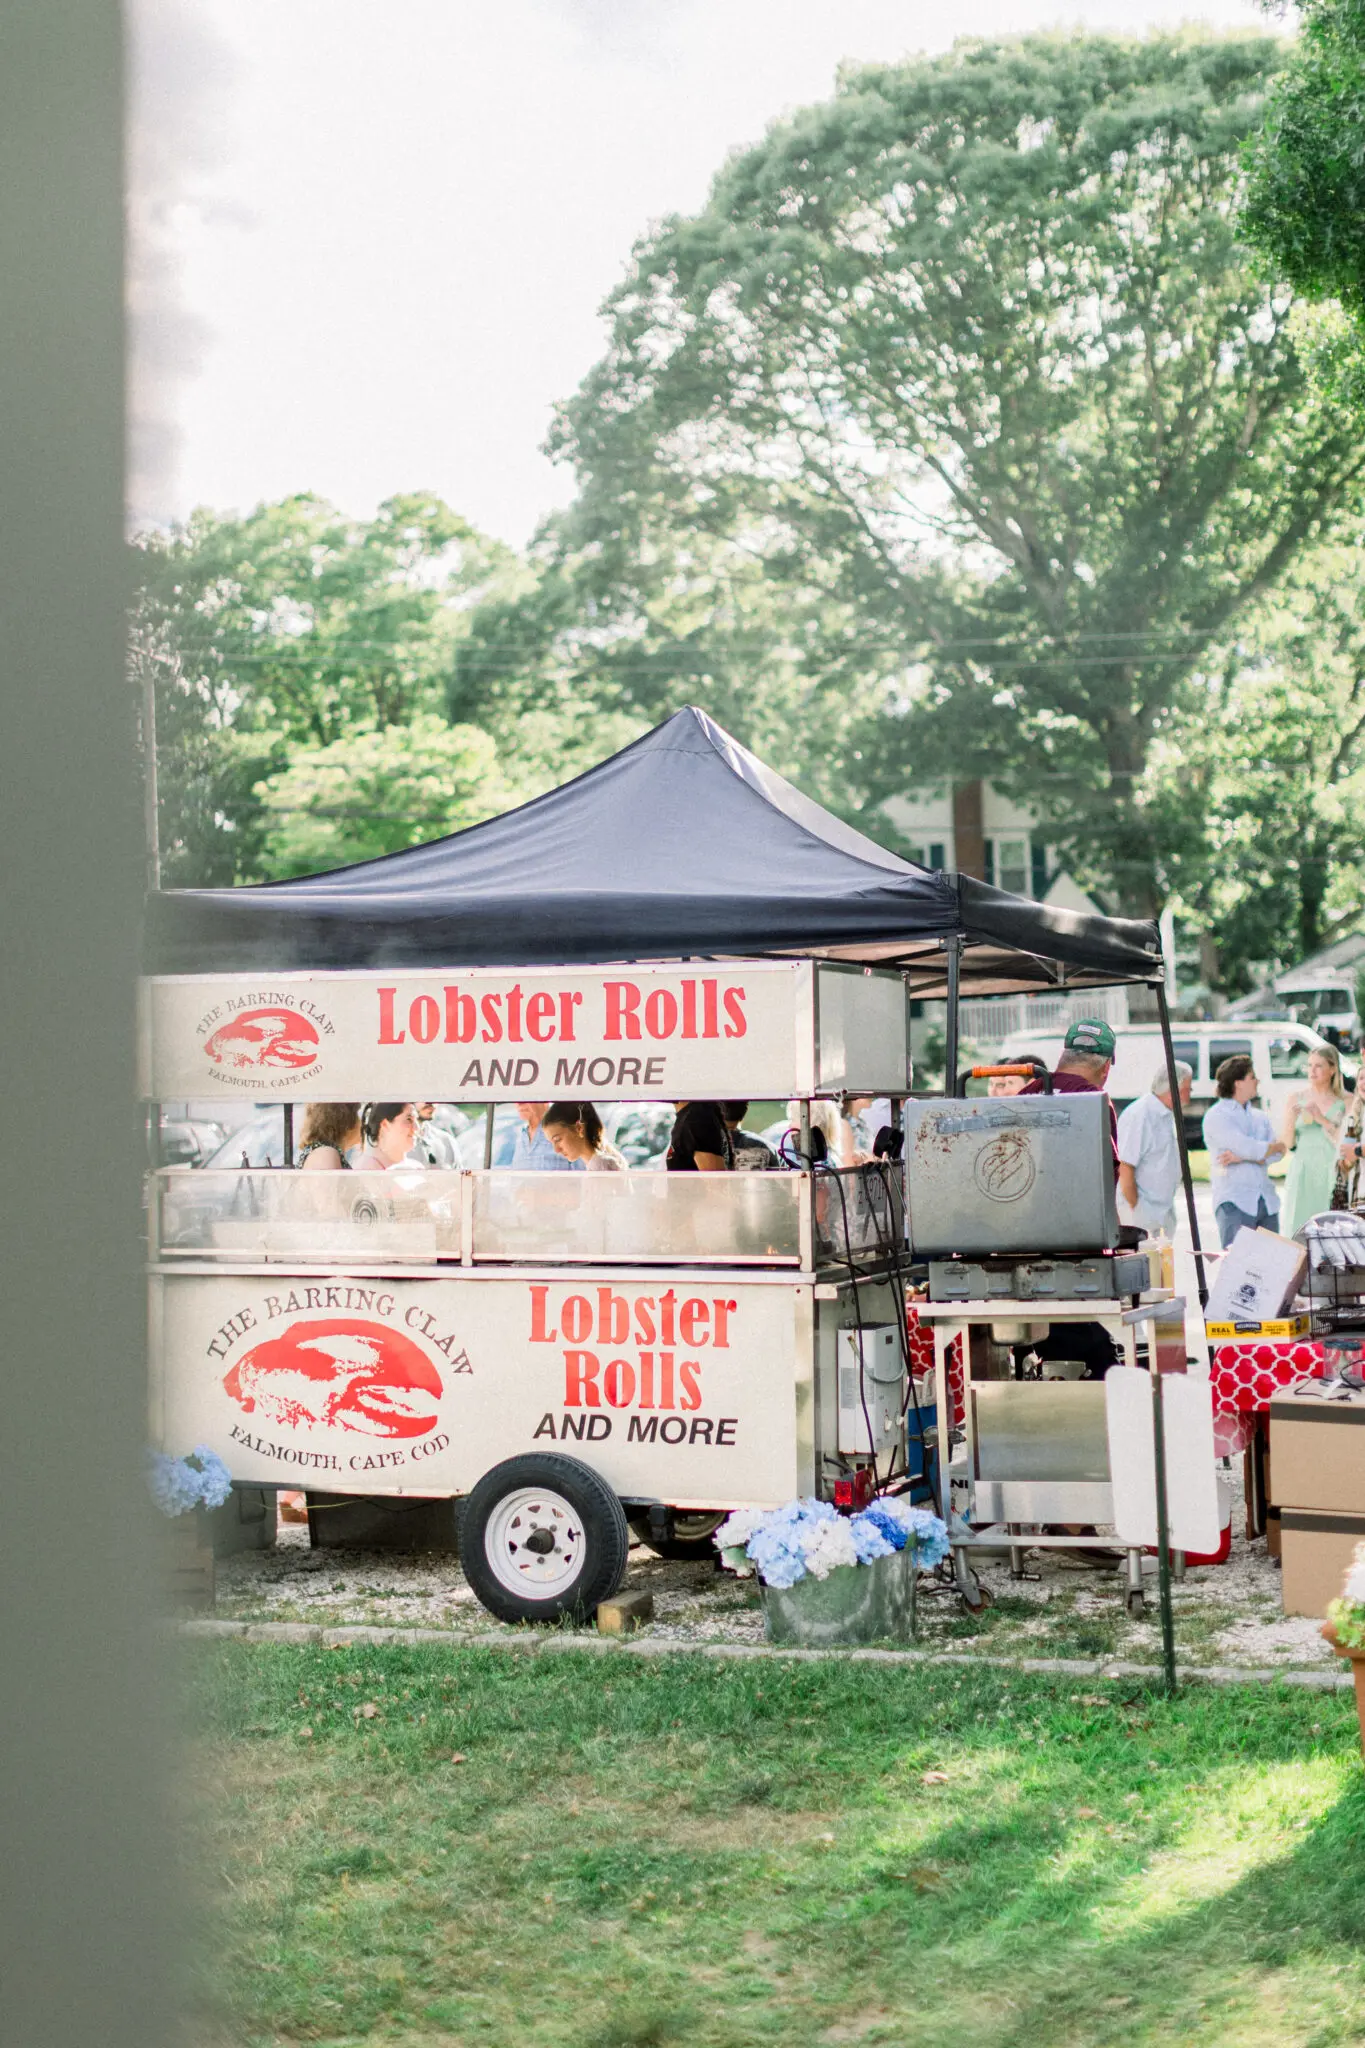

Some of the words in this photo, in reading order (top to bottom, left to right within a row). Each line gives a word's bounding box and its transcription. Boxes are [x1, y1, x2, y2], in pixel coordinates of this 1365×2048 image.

[196, 1006, 224, 1036] THE
[226, 992, 295, 1012] BARKING
[299, 999, 336, 1036] CLAW
[377, 984, 583, 1044] Lobster
[603, 979, 747, 1040] Rolls
[270, 1075, 301, 1088] CAPE
[302, 1064, 324, 1081] COD
[459, 1058, 539, 1087] AND
[554, 1056, 666, 1085] MORE
[207, 1308, 258, 1361] THE
[263, 1286, 397, 1320] BARKING
[404, 1306, 474, 1376] CLAW
[528, 1285, 737, 1348] Lobster
[563, 1350, 702, 1411] Rolls
[228, 1424, 343, 1473] FALMOUTH,
[349, 1450, 405, 1471] CAPE
[410, 1432, 451, 1461] COD
[533, 1413, 612, 1441] AND
[627, 1415, 738, 1445] MORE
